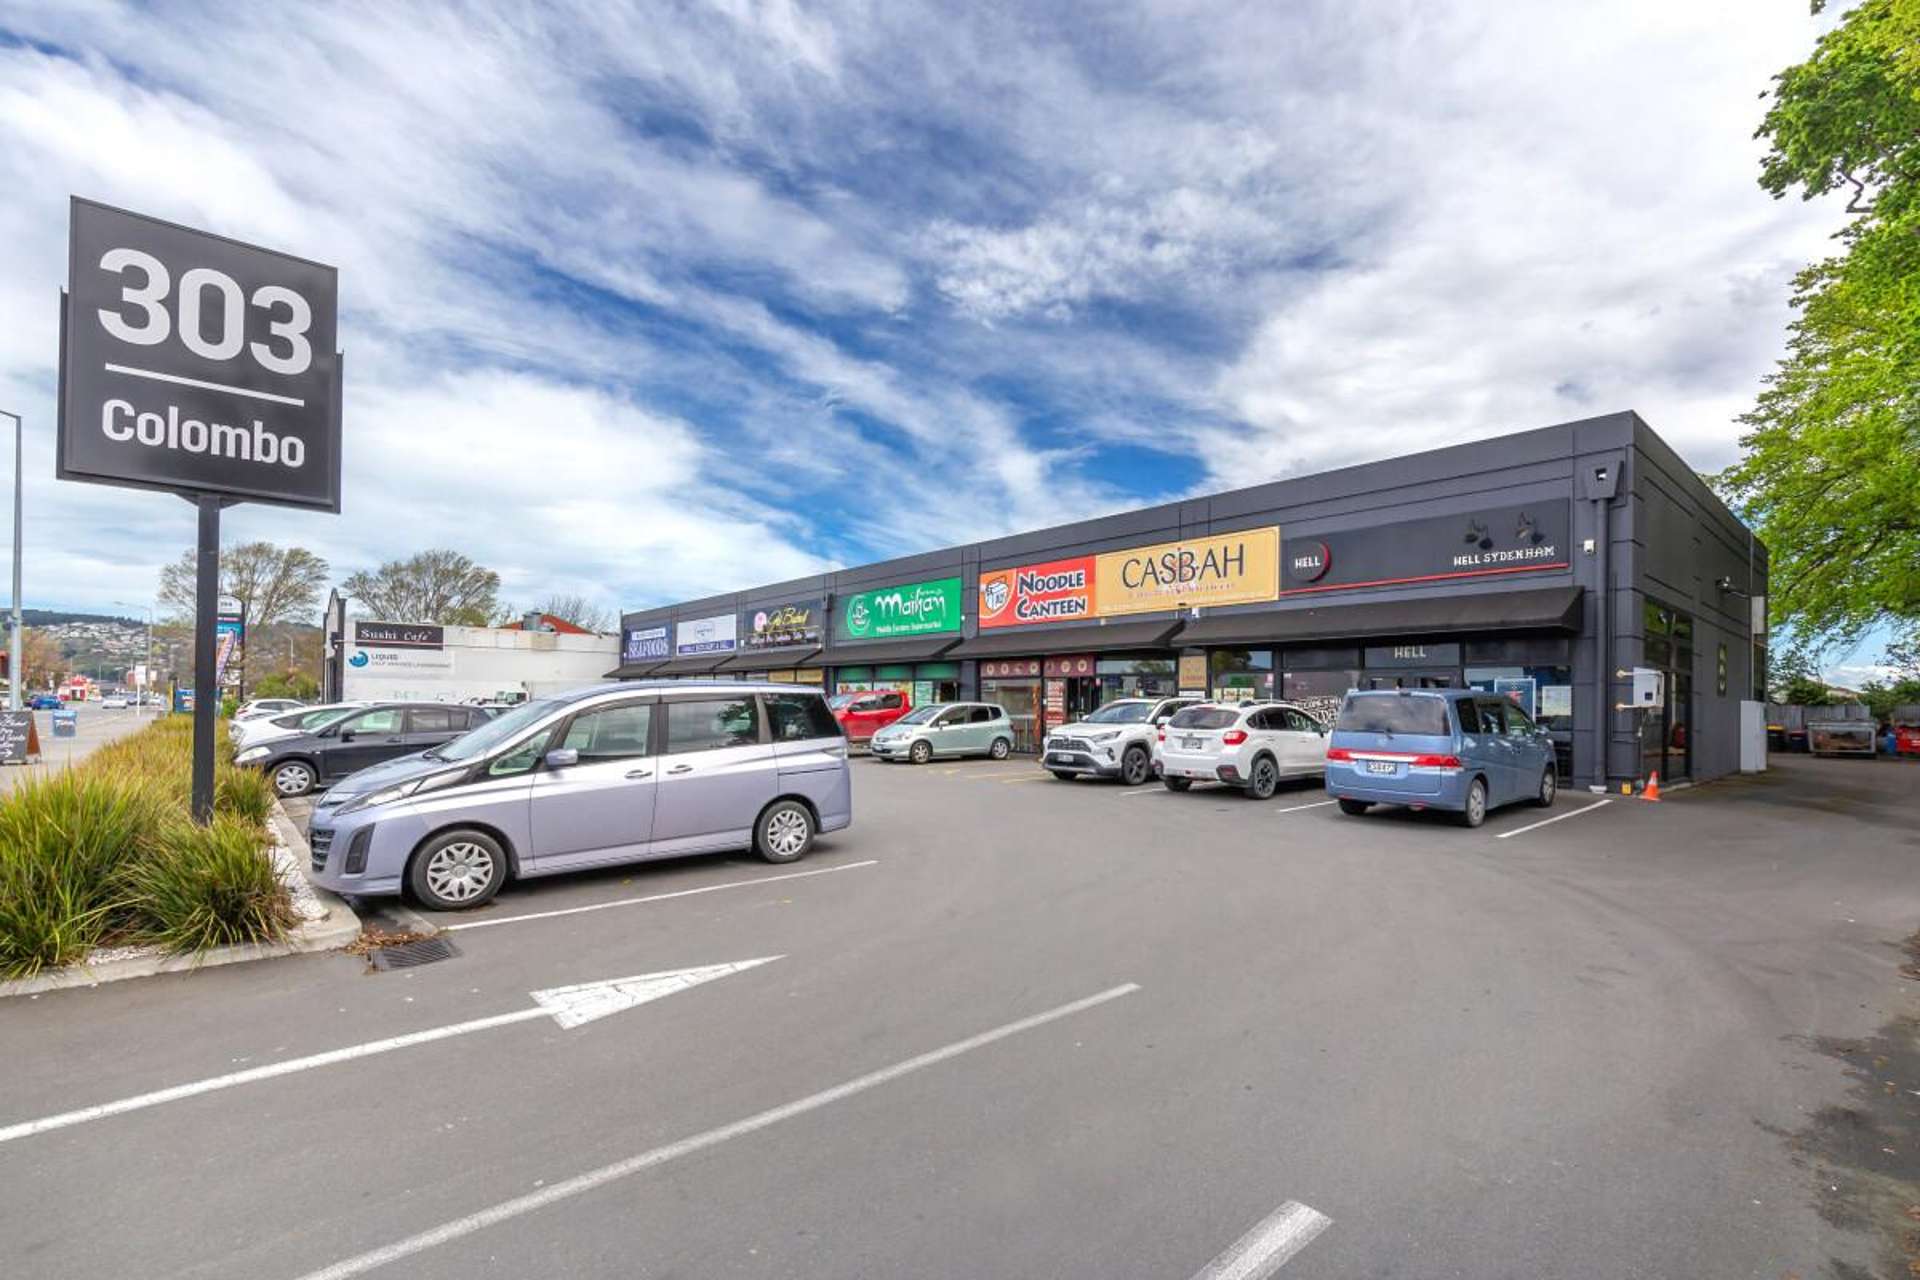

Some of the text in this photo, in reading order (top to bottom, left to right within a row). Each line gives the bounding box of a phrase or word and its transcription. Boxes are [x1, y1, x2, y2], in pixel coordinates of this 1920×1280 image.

[97, 247, 312, 375] 303
[102, 398, 305, 468] Colombo
[1122, 543, 1244, 589] CASBAH
[1295, 555, 1321, 569] HELL
[1453, 545, 1555, 567] HELL SYDENHAM
[1018, 570, 1085, 596] NOODLE
[1016, 597, 1087, 619] CANTEEN
[361, 629, 397, 640] Sushi
[1394, 644, 1427, 659] HELL
